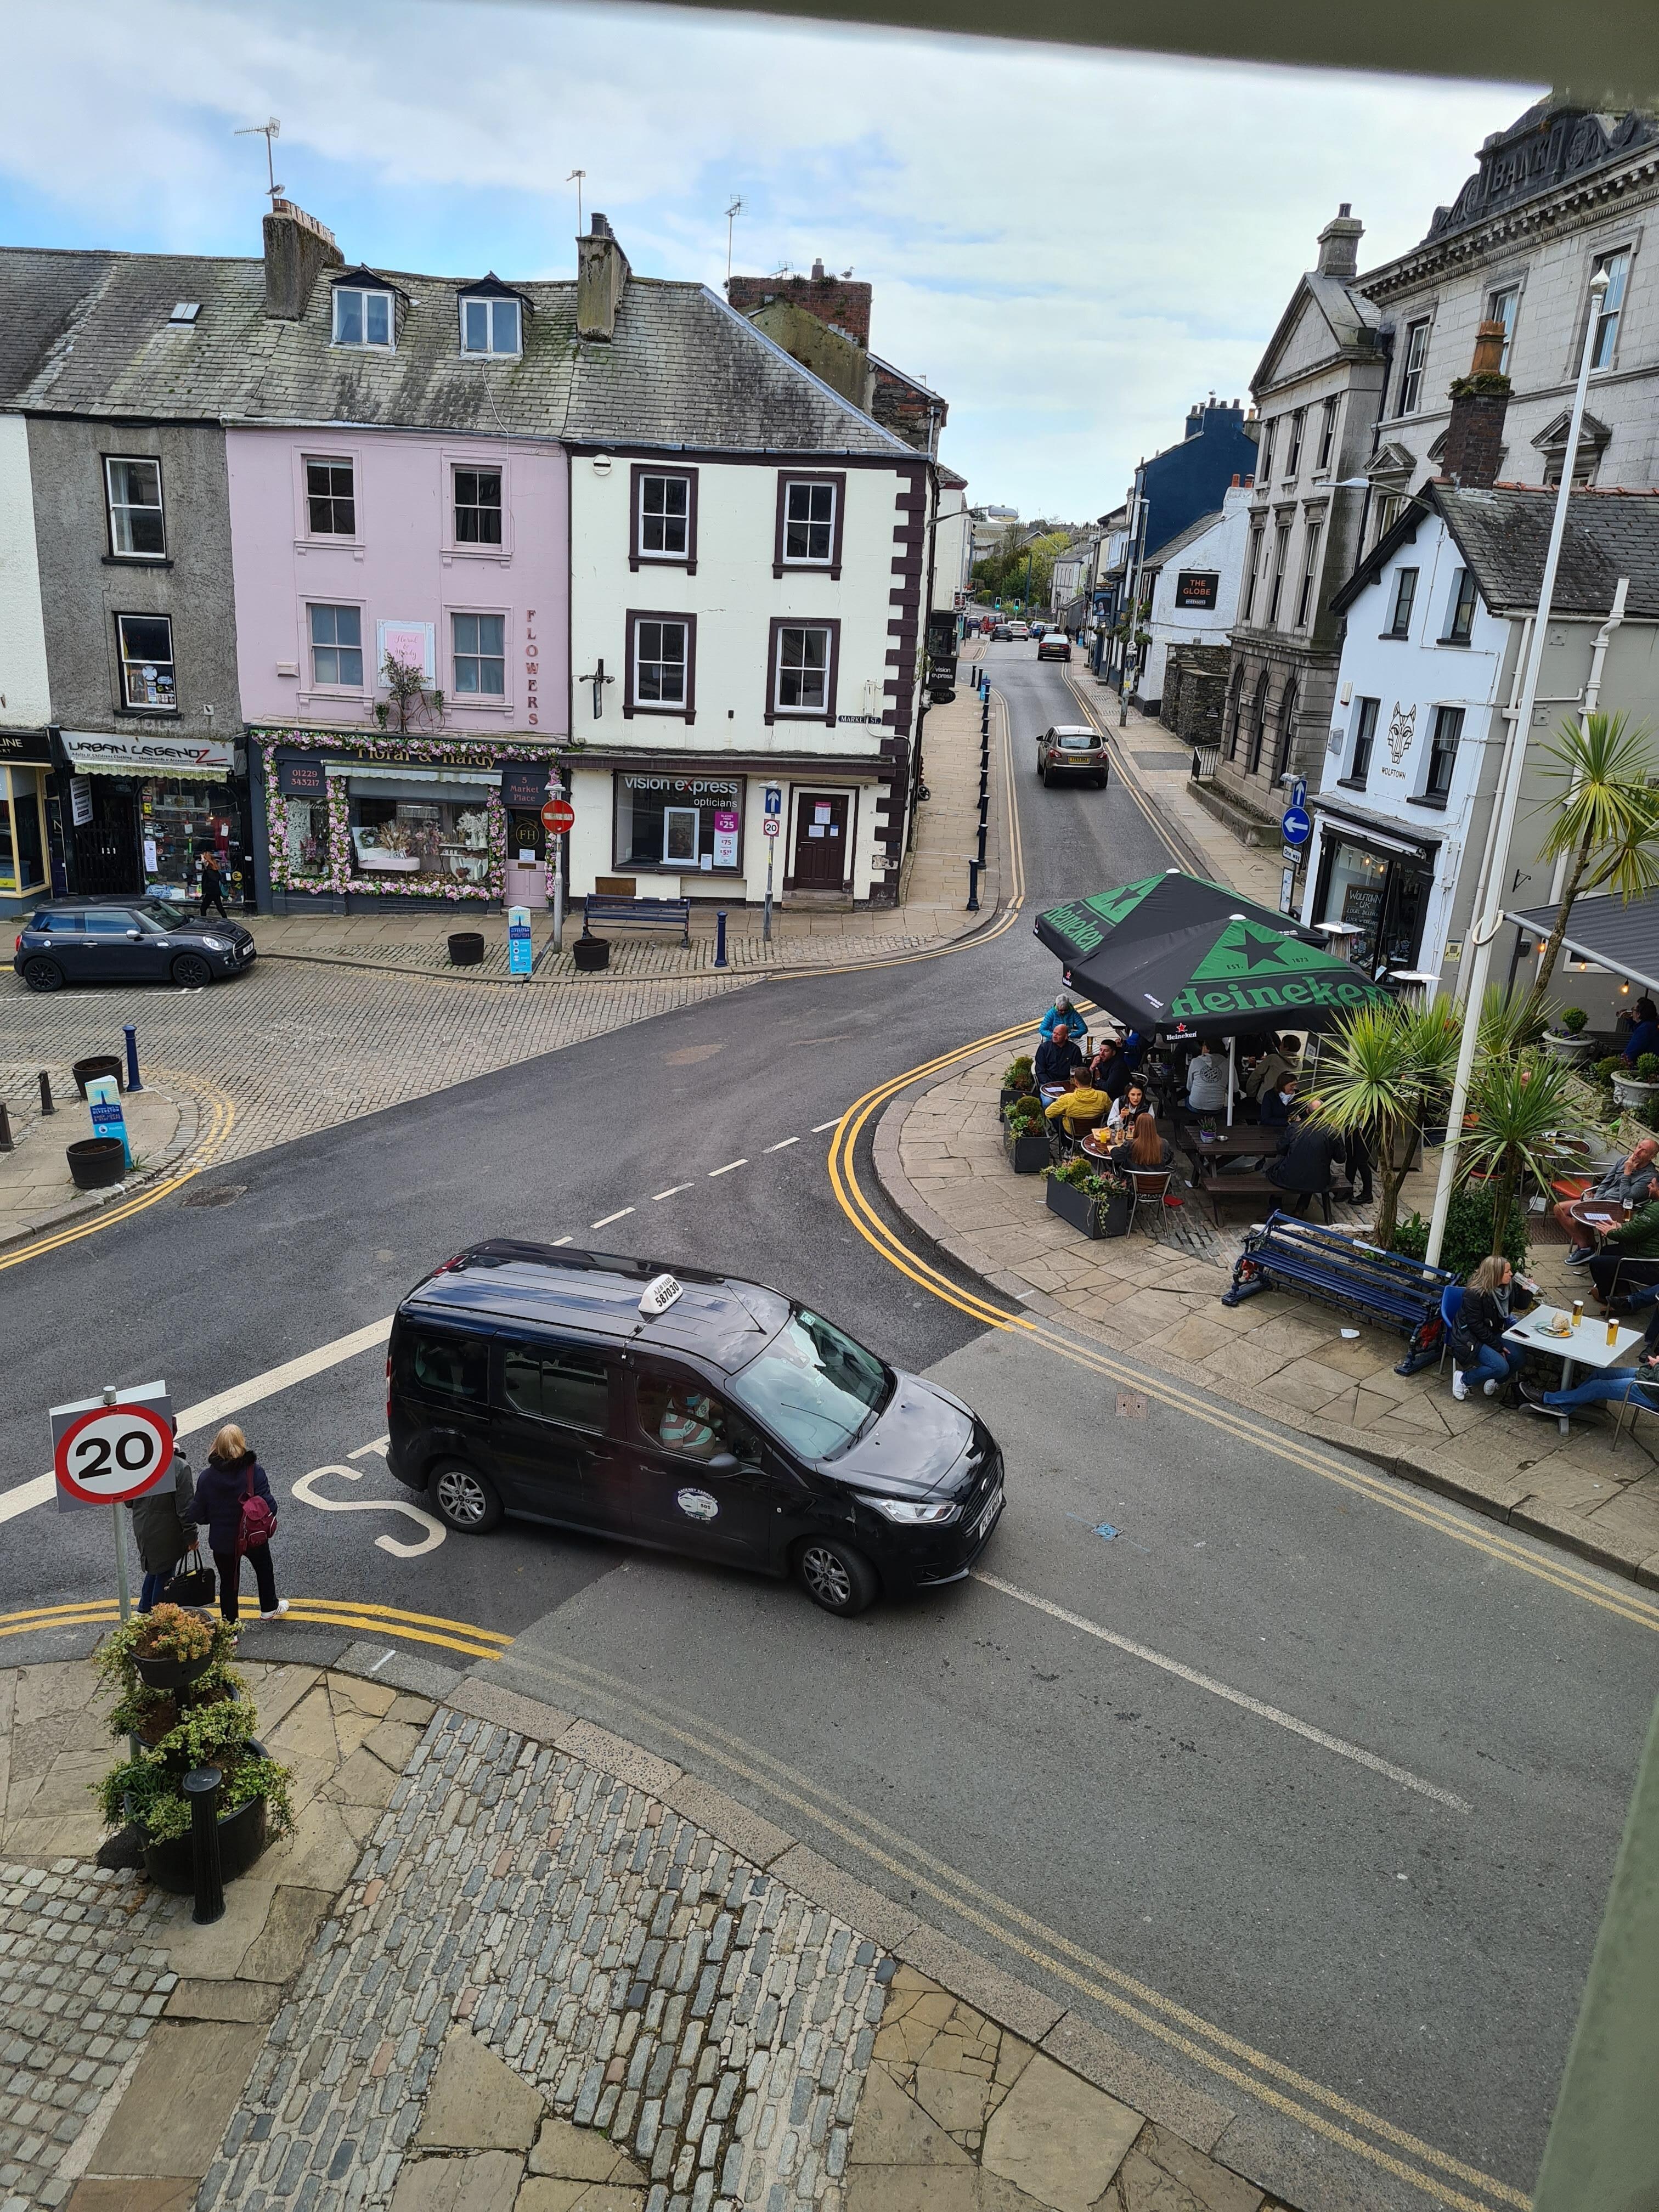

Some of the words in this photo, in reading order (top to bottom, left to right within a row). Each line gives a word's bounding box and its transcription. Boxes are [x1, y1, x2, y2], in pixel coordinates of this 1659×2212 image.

[1491, 136, 1551, 194] BANK
[526, 610, 539, 725] FLOWERS
[69, 742, 127, 754] URBAN
[292, 769, 317, 777] 01229
[1381, 766, 1406, 780] WOLFTOWN
[291, 778, 319, 786] 343217
[510, 785, 539, 793] Market
[624, 777, 670, 791] vision
[675, 777, 738, 795] express
[292, 797, 328, 812] Weddings
[694, 797, 737, 808] opticians
[720, 821, 734, 829] £25
[520, 830, 535, 840] FH
[1350, 890, 1383, 904] WOLFTOWN
[1171, 977, 1396, 1017] Heineken
[1166, 1031, 1197, 1041] Heineken
[655, 1281, 680, 1307] 587030
[75, 1431, 154, 1480] 20
